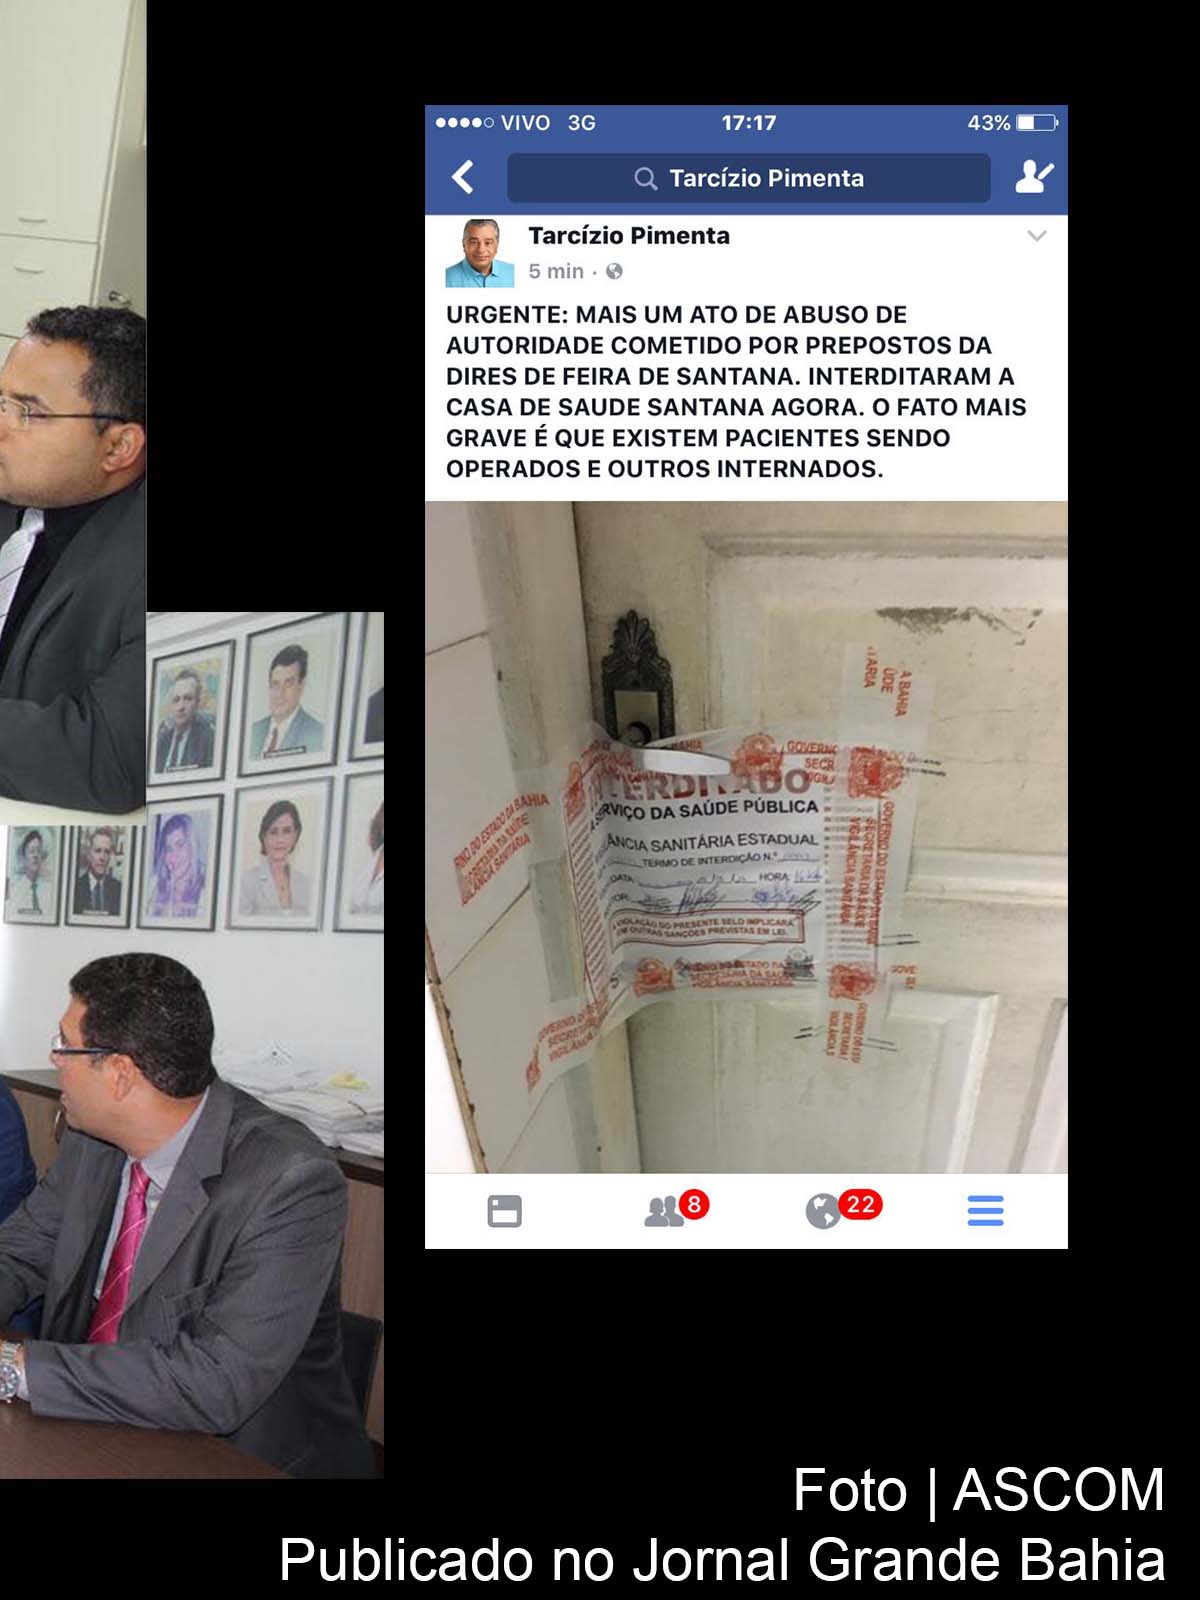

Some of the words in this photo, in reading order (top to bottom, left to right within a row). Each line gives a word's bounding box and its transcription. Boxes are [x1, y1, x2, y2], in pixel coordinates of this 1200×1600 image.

[500, 114, 551, 131] VIVO
[568, 114, 596, 131] 3G
[722, 114, 777, 131] 17:17
[967, 114, 1011, 131] 43%
[670, 166, 762, 188] Tarcízio
[768, 168, 865, 188] Pimenta
[528, 223, 624, 245] Tarcízio
[631, 225, 730, 245] Pimenta
[529, 263, 541, 280] 5
[547, 262, 584, 280] min
[447, 305, 568, 324] URGENTE:
[576, 305, 637, 324] MAIS
[644, 305, 682, 324] UM
[689, 305, 738, 324] ATO
[745, 305, 776, 324] DE
[783, 305, 869, 324] ABUSO
[876, 305, 907, 324] DE
[446, 335, 604, 355] AUTORIDADE
[611, 335, 742, 355] COMETIDO
[749, 335, 799, 355] POR
[806, 335, 952, 355] PREPOSTOS
[959, 336, 993, 355] DA
[447, 366, 517, 386] DIRES
[524, 367, 556, 386] DE
[563, 367, 631, 386] FEIRA
[639, 367, 669, 386] DE
[676, 366, 801, 386] SANTANA.
[809, 367, 991, 386] INTERDITARAM
[998, 367, 1015, 386] A
[446, 397, 513, 417] CASA
[520, 397, 551, 416] DE
[558, 397, 641, 417] SAUDE
[647, 397, 765, 417] SANTANA
[770, 397, 865, 417] AGORA.
[872, 397, 890, 417] O
[897, 397, 958, 417] FATO
[966, 397, 1027, 417] MAIS
[446, 428, 527, 448] GRAVE
[535, 423, 548, 447] É
[554, 428, 605, 449] QUE
[612, 428, 718, 448] EXISTEM
[726, 428, 860, 448] PACIENTES
[866, 428, 951, 448] SENDO
[446, 459, 581, 478] OPERADOS
[588, 459, 601, 478] E
[607, 459, 711, 478] OUTROS
[717, 459, 883, 479] INTERNADOS.
[895, 681, 912, 717] BAHIA
[513, 793, 550, 811] BAHIA
[650, 806, 676, 820] DA
[679, 799, 738, 818] SAÚDE
[744, 797, 818, 814] PÚBLICA
[650, 832, 735, 853] SANITÁRIA
[737, 832, 820, 847] ESTADUAL
[688, 1195, 701, 1214] 8
[846, 1195, 876, 1214] 22
